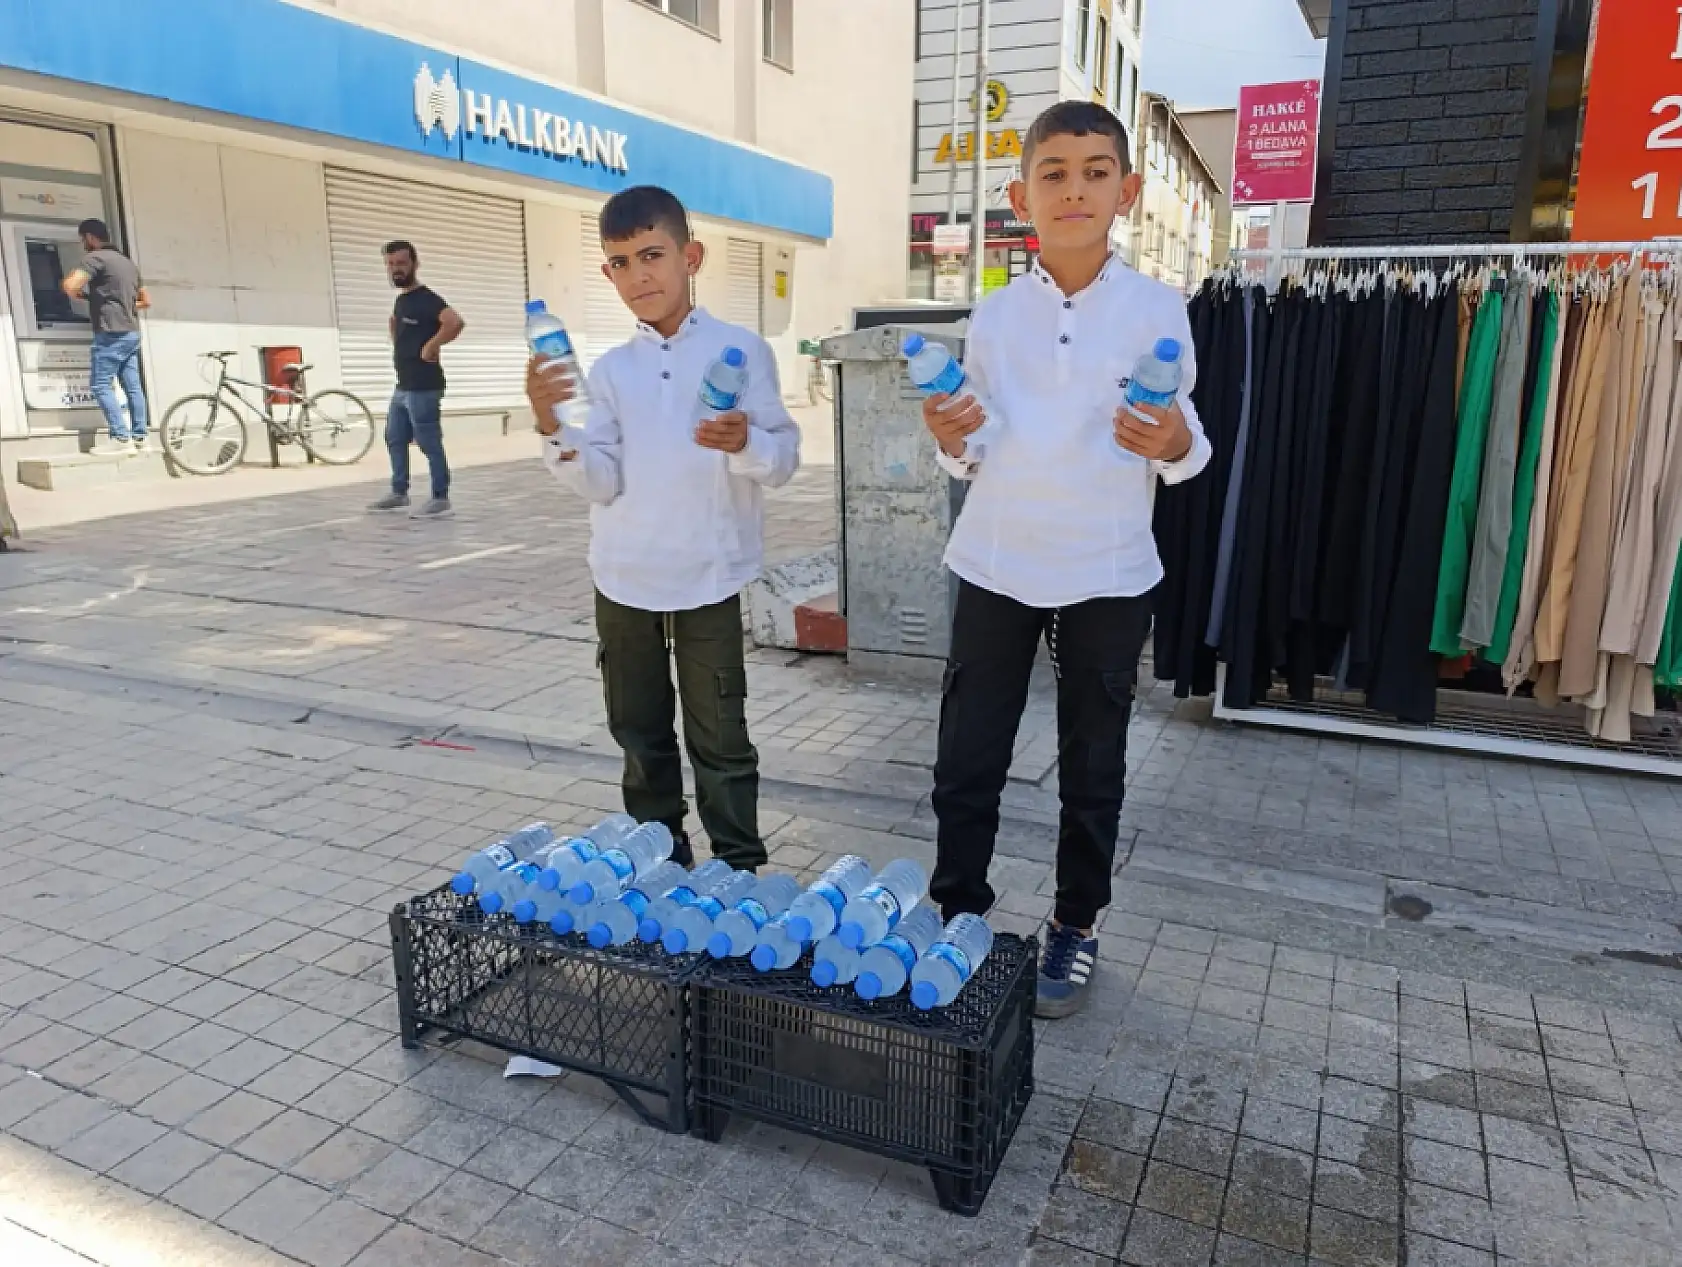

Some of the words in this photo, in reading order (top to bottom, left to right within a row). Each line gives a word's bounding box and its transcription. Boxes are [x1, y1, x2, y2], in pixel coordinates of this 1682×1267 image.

[462, 88, 629, 173] HALKBANK
[1249, 123, 1258, 136] 2
[1260, 119, 1308, 135] ALANA
[1254, 136, 1307, 150] BEDAVA
[1646, 94, 1682, 150] 2
[1631, 172, 1659, 219] 1
